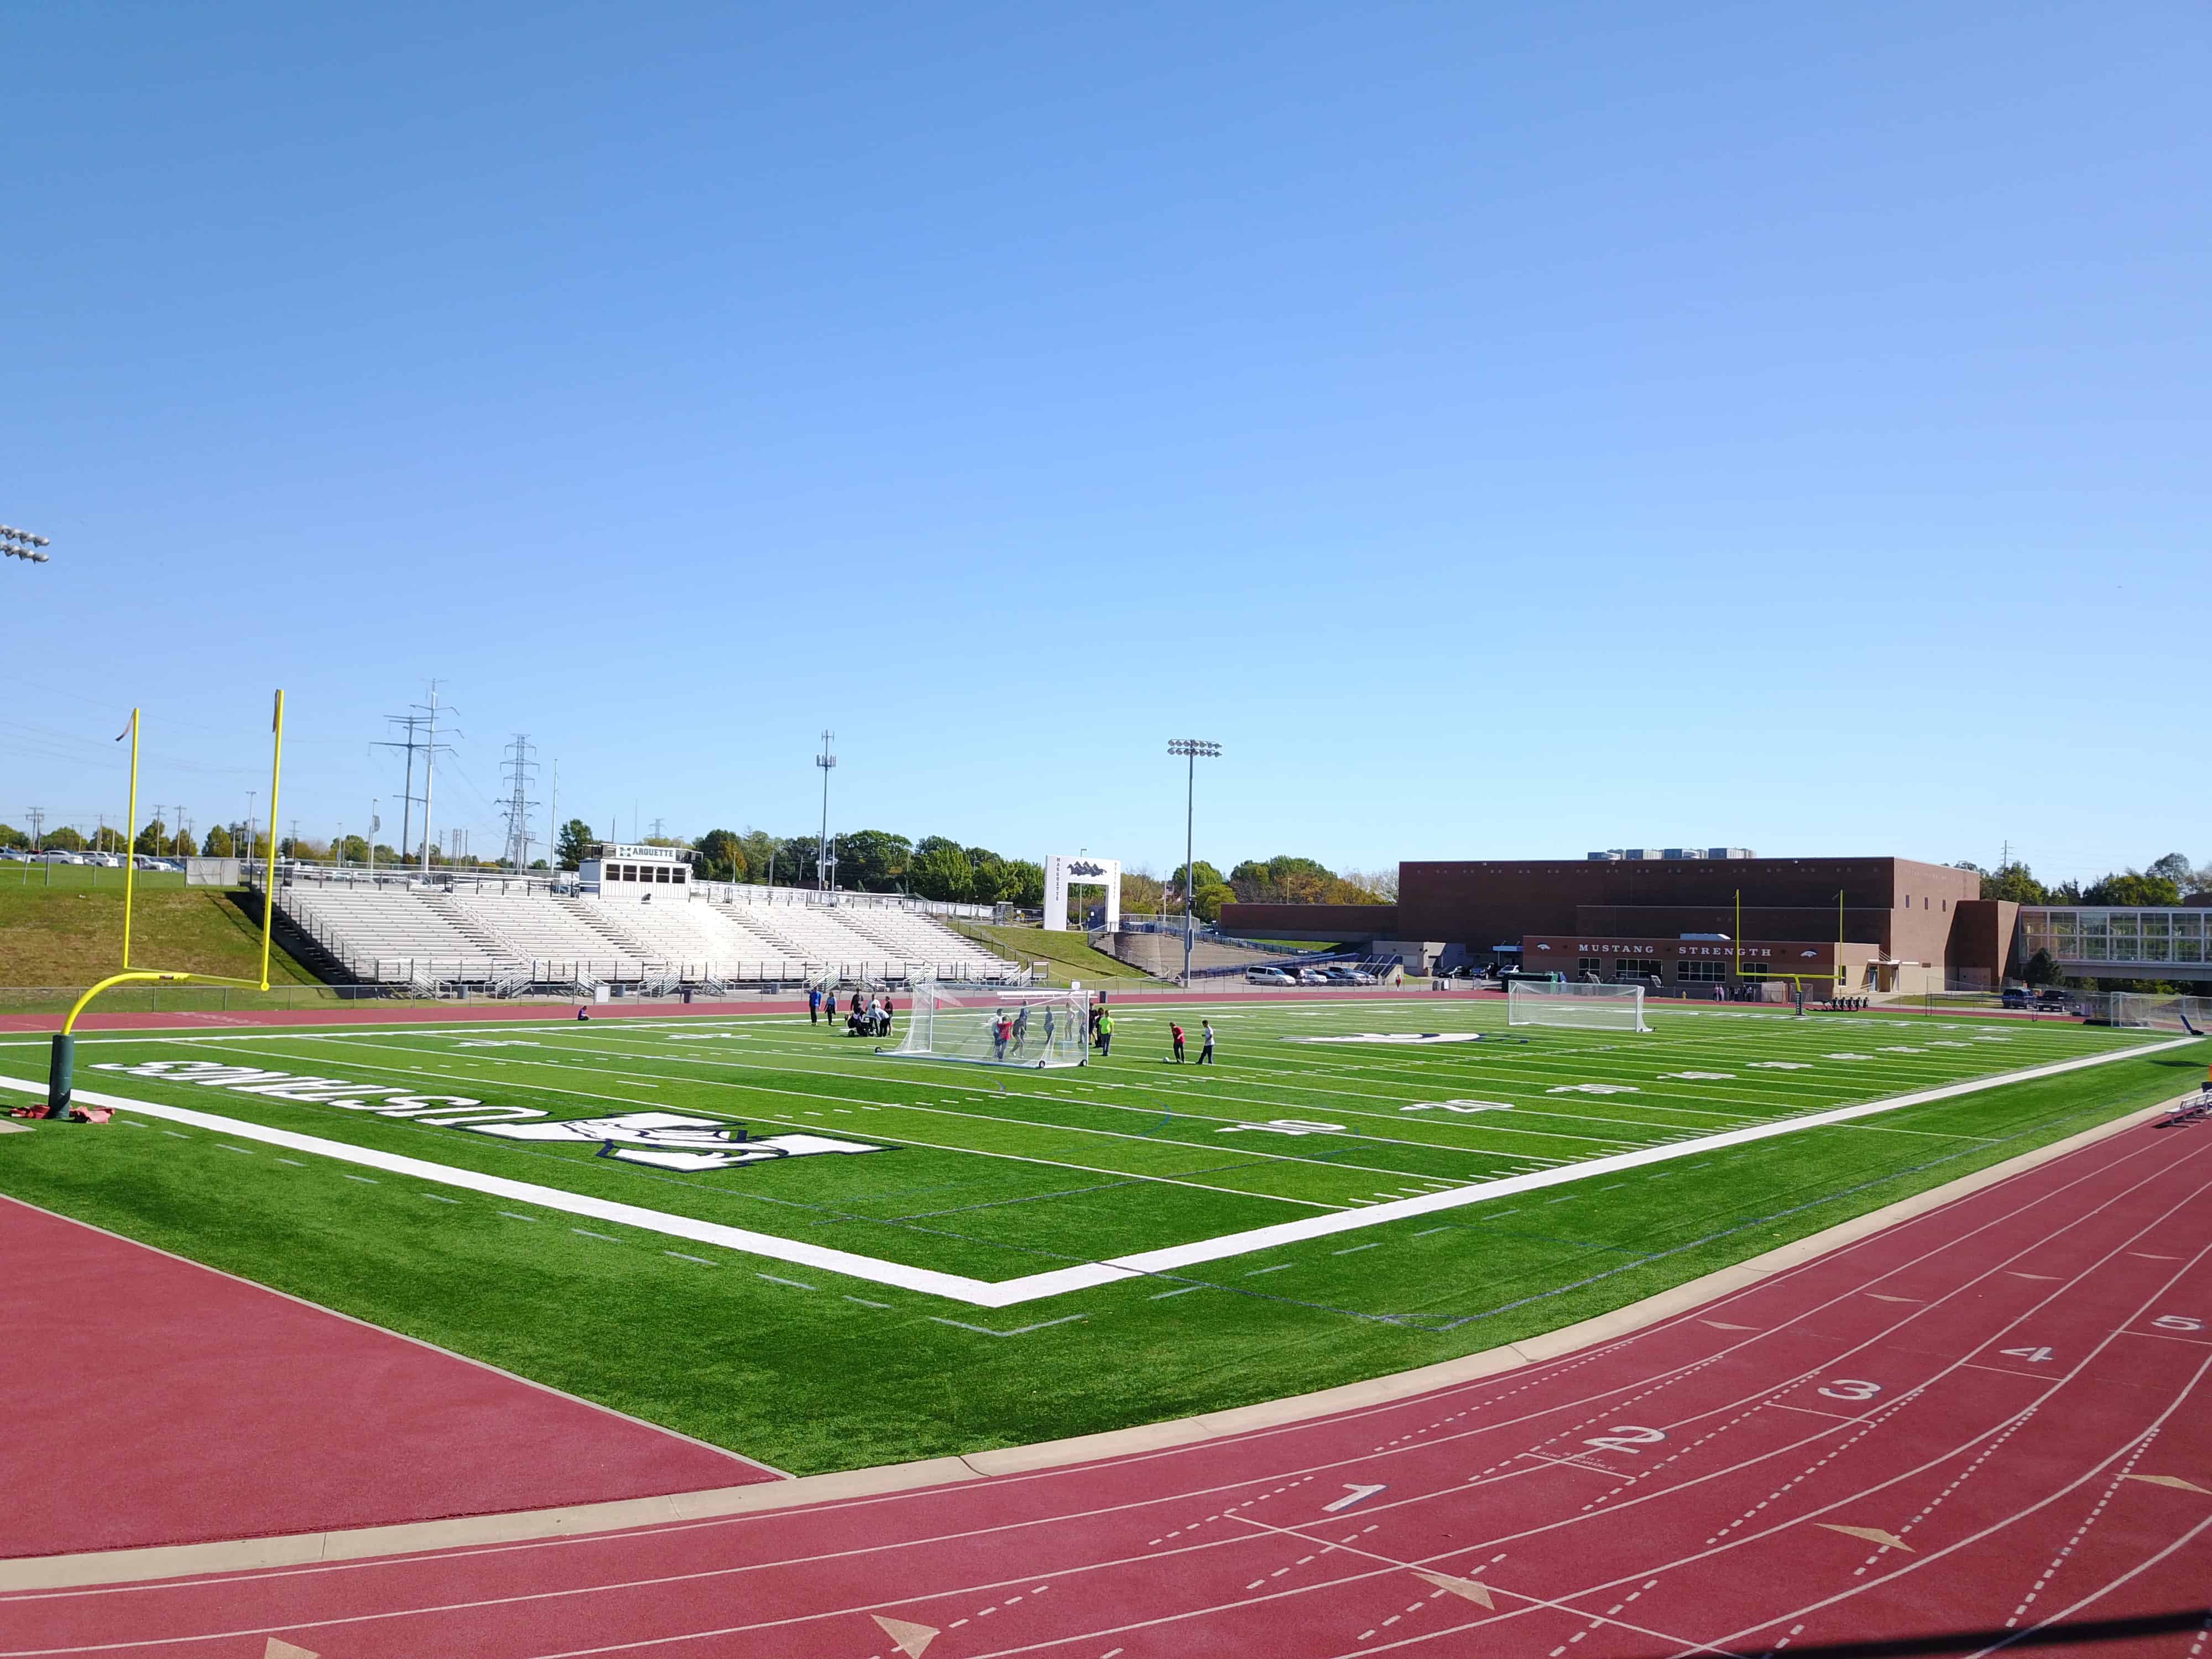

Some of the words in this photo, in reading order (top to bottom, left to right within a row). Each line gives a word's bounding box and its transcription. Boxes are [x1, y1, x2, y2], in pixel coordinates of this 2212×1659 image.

[1579, 943, 1655, 953] MUSTANG
[1678, 946, 1772, 957] STRENGTH
[1413, 1099, 1515, 1113] 20
[1235, 1119, 1348, 1135] 10
[2151, 1314, 2203, 1331] 5
[1999, 1347, 2053, 1362] 4
[1817, 1379, 1884, 1400] 3
[1581, 1425, 1667, 1454] 2
[1322, 1484, 1389, 1512] 1
